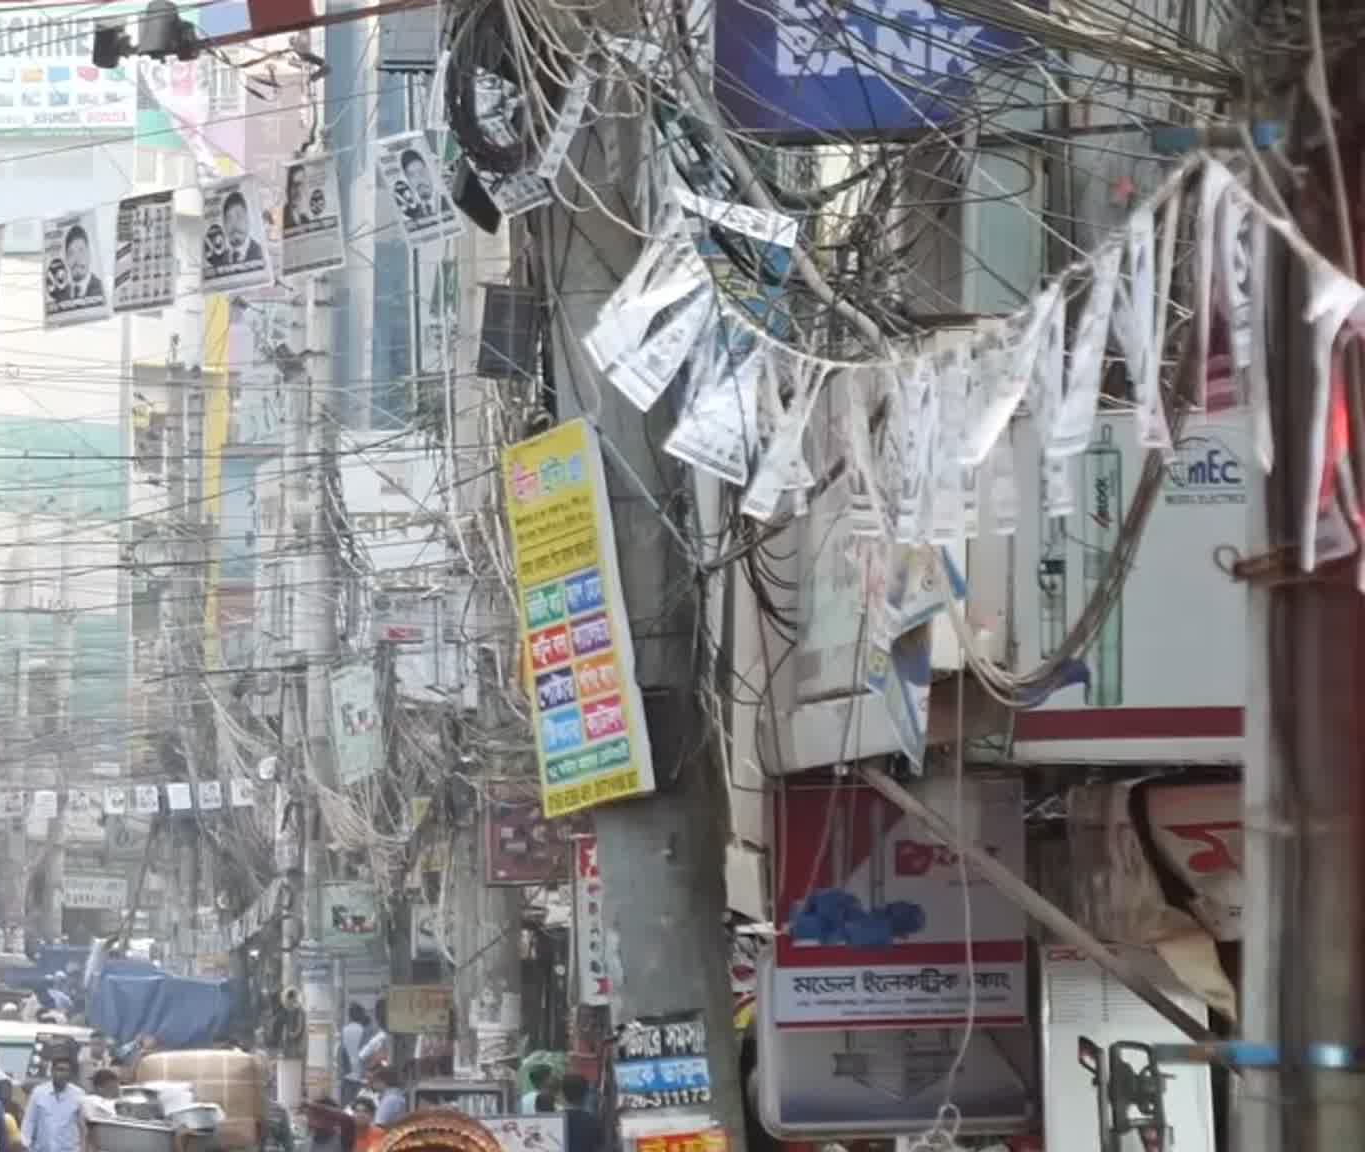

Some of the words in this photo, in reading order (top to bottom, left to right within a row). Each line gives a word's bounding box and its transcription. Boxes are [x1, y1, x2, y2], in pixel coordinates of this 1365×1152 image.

[777, 25, 983, 77] BANK
[793, 974, 857, 997] মডেল
[862, 967, 958, 993] ইলেকট্রিক
